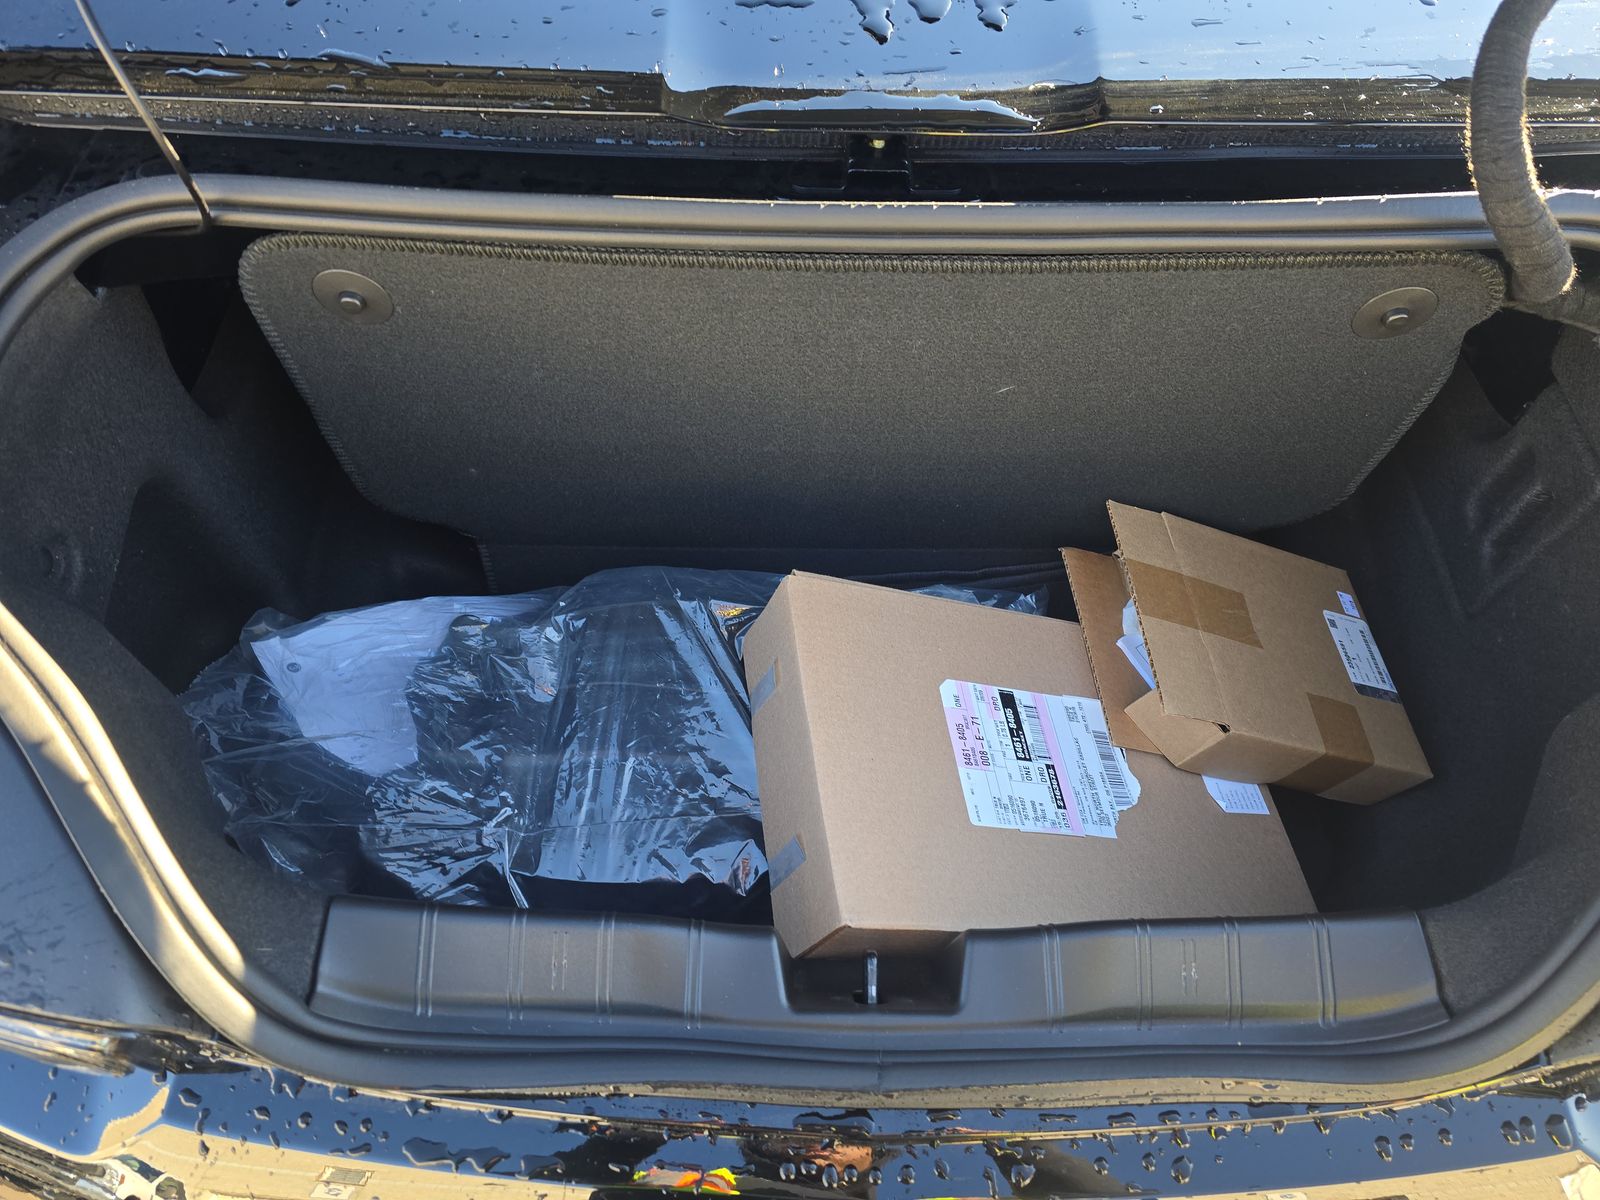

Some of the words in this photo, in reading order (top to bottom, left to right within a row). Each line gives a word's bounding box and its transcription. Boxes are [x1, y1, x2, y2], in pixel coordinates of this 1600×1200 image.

[953, 694, 961, 707] ONE
[1074, 737, 1082, 760] CADILLAC
[1023, 765, 1033, 781] ONE
